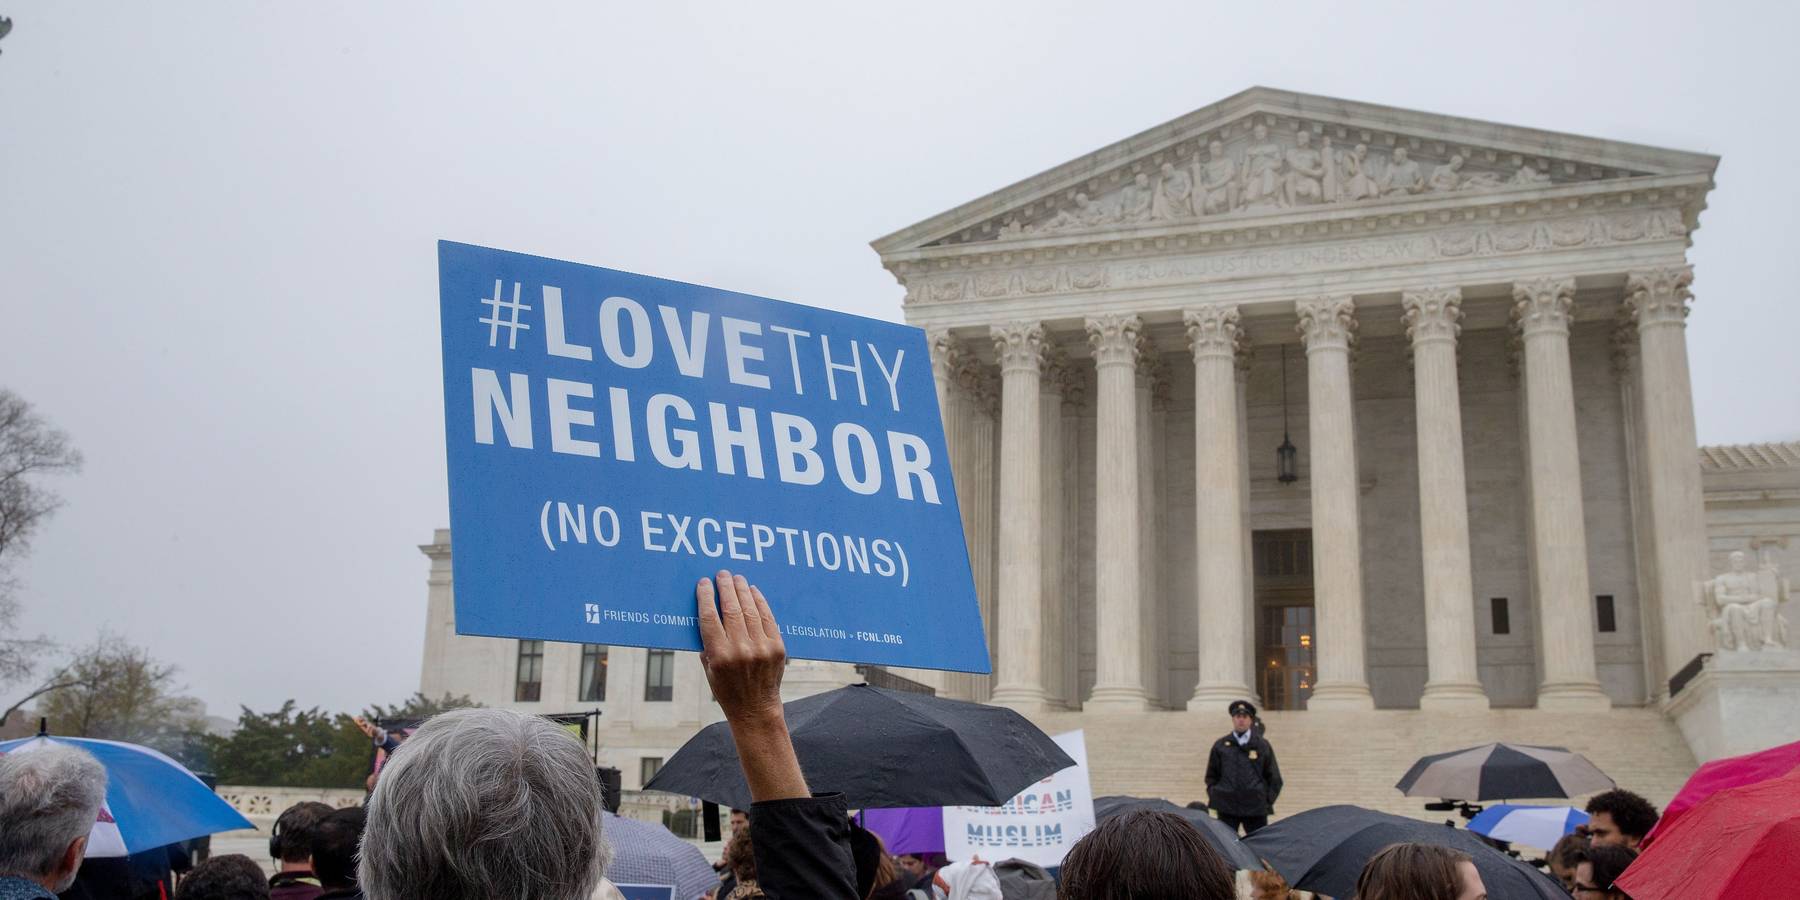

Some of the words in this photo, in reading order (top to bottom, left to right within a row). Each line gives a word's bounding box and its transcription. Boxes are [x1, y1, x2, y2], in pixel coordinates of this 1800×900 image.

[1124, 258, 1193, 281] EQUAL
[1201, 251, 1281, 275] JUSTICE
[1292, 245, 1361, 267] UNDER
[1373, 239, 1414, 259] LAW
[471, 367, 942, 505] NEIGHBOR
[540, 500, 621, 551] (NO
[640, 510, 909, 587] EXCEPTIONS)
[604, 609, 649, 624] FRIENDS
[786, 624, 846, 640] LEGISLATION
[857, 631, 903, 645] FCNL.ORG
[967, 823, 1063, 847] MUSLIM
